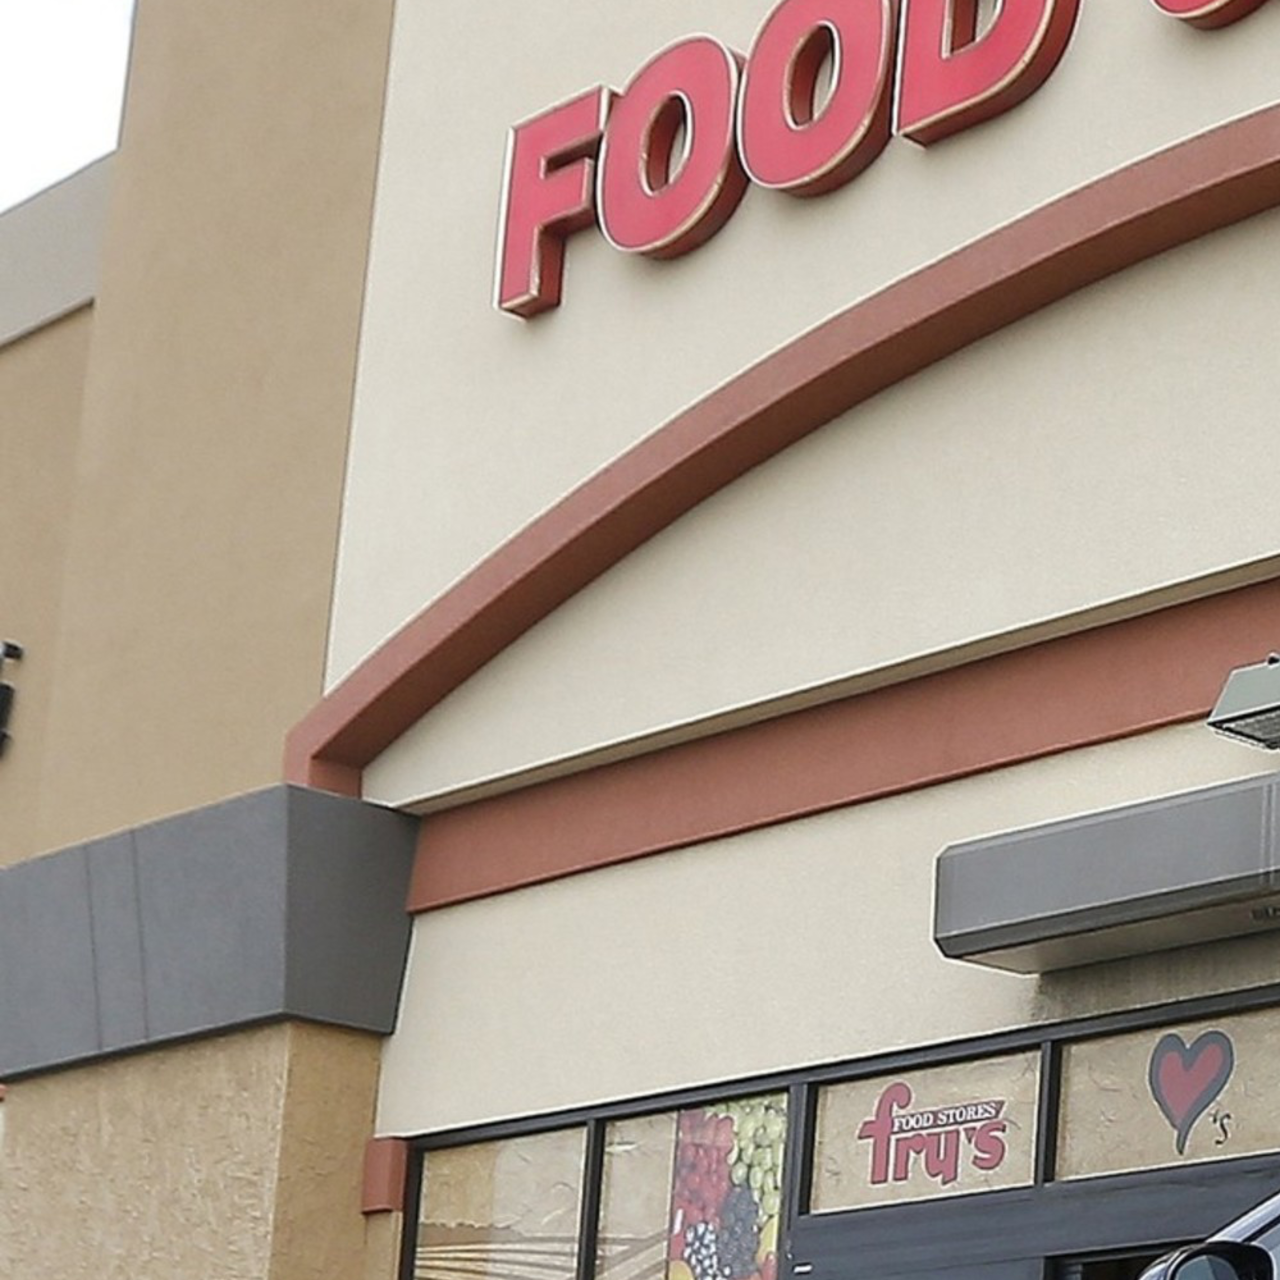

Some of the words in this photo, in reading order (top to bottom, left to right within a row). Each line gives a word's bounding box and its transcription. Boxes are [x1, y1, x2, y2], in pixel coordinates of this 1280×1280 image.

[494, 0, 1078, 320] FOOD
[858, 1082, 1006, 1185] fry's
[893, 1112, 934, 1133] FOOD
[937, 1102, 997, 1126] STORES
